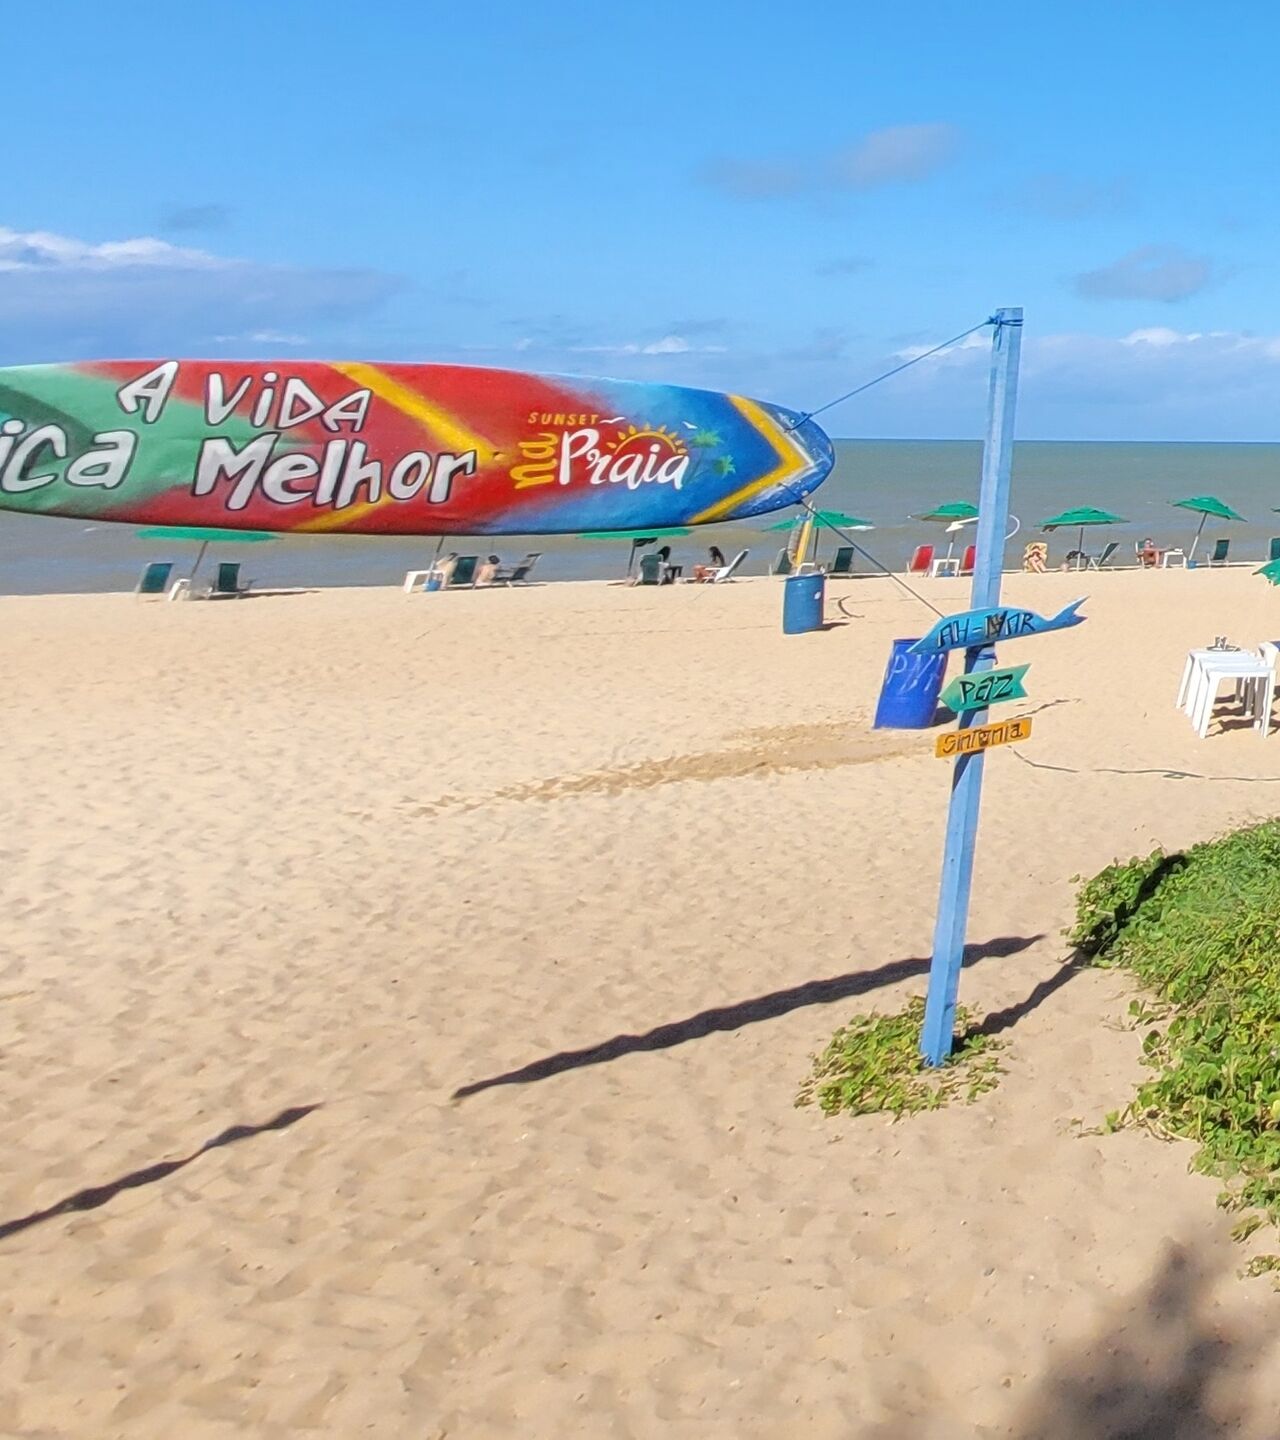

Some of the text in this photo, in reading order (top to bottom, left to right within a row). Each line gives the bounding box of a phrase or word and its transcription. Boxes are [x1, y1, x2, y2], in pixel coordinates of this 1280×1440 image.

[117, 360, 179, 424] A
[528, 412, 599, 426] SUNSET
[191, 431, 477, 510] Melhor
[559, 428, 690, 491] Praia
[937, 610, 1036, 649] AH-MAR
